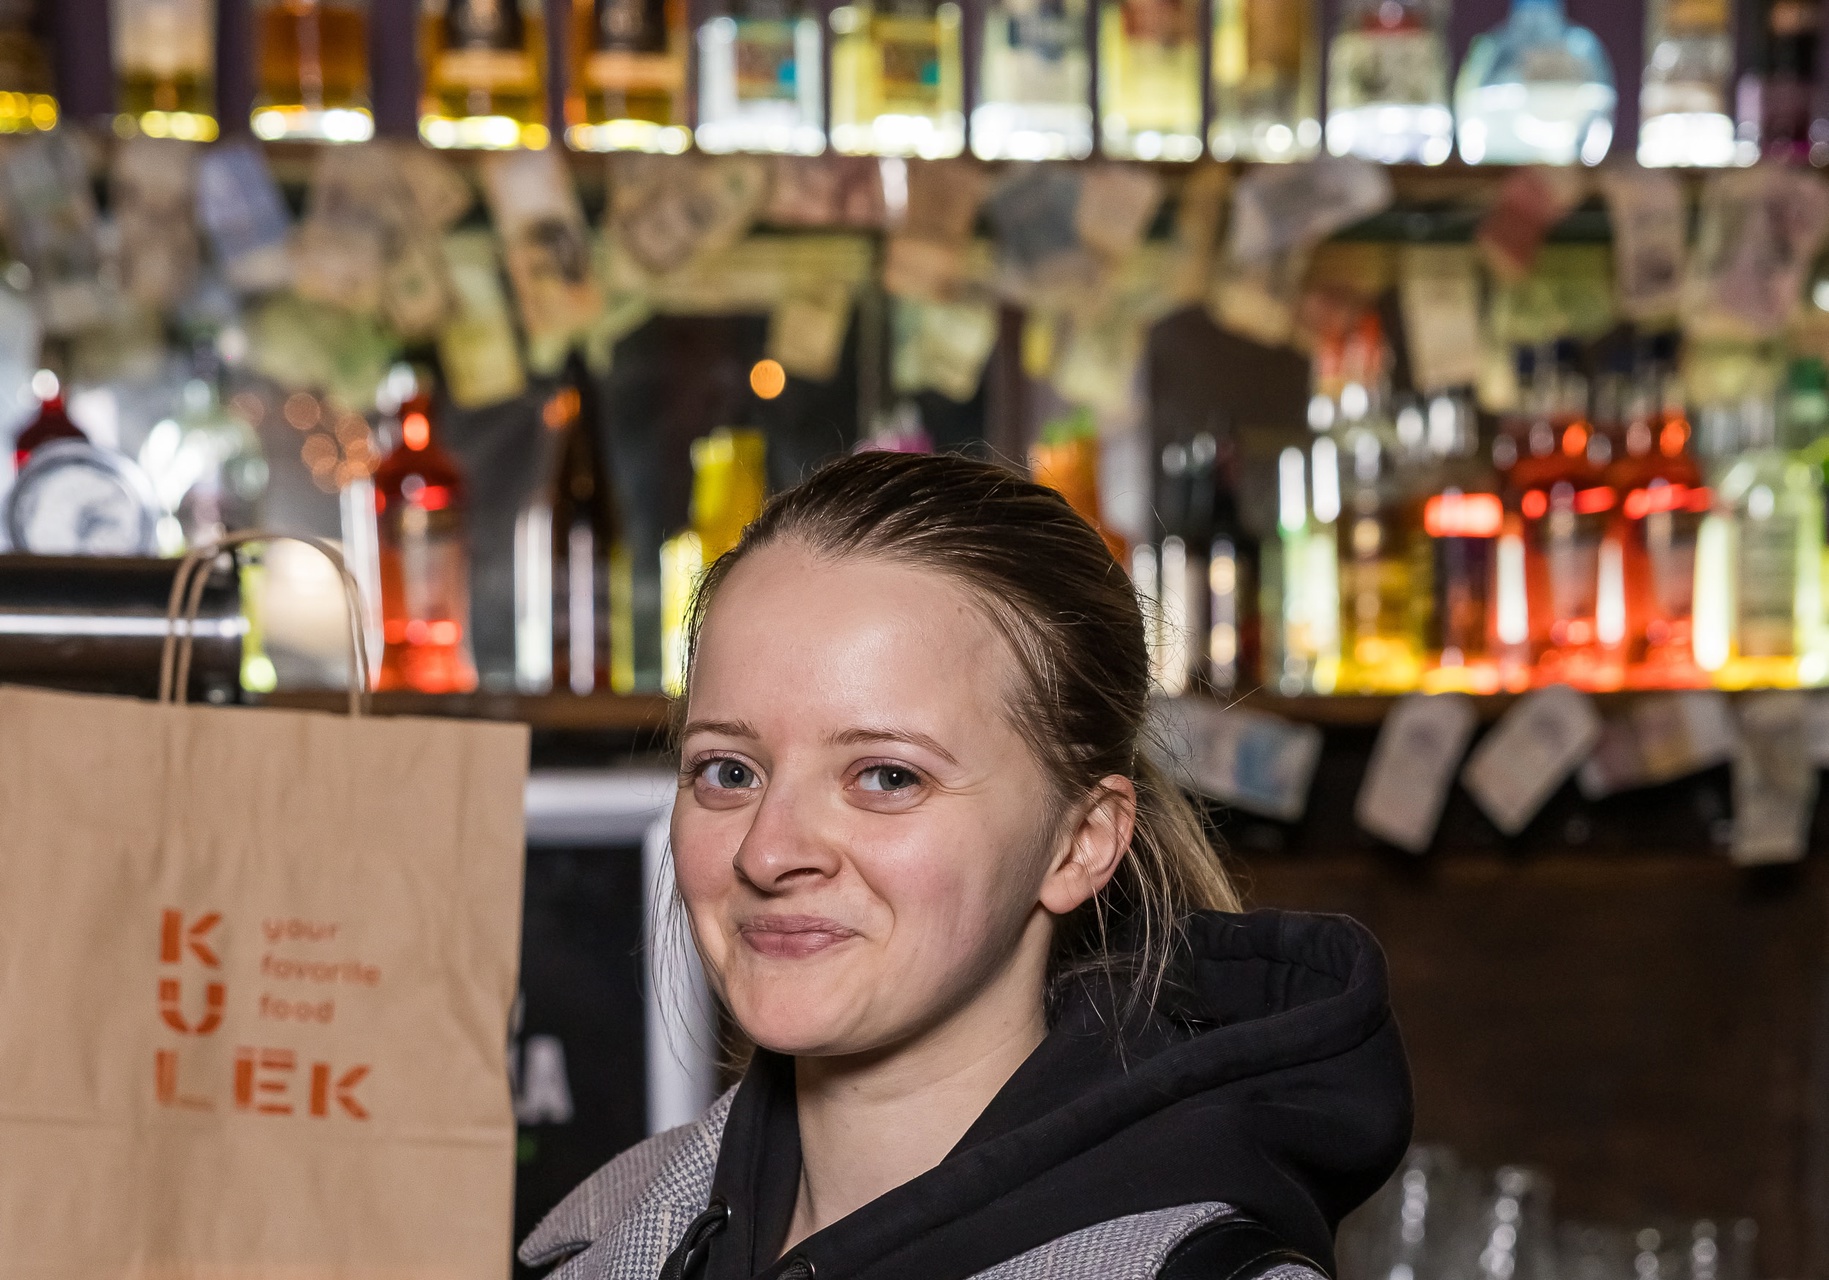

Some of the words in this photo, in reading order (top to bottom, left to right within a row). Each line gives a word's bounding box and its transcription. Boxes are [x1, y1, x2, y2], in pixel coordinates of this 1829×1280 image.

[261, 917, 338, 943] your
[260, 952, 381, 987] favorite
[259, 992, 336, 1024] food
